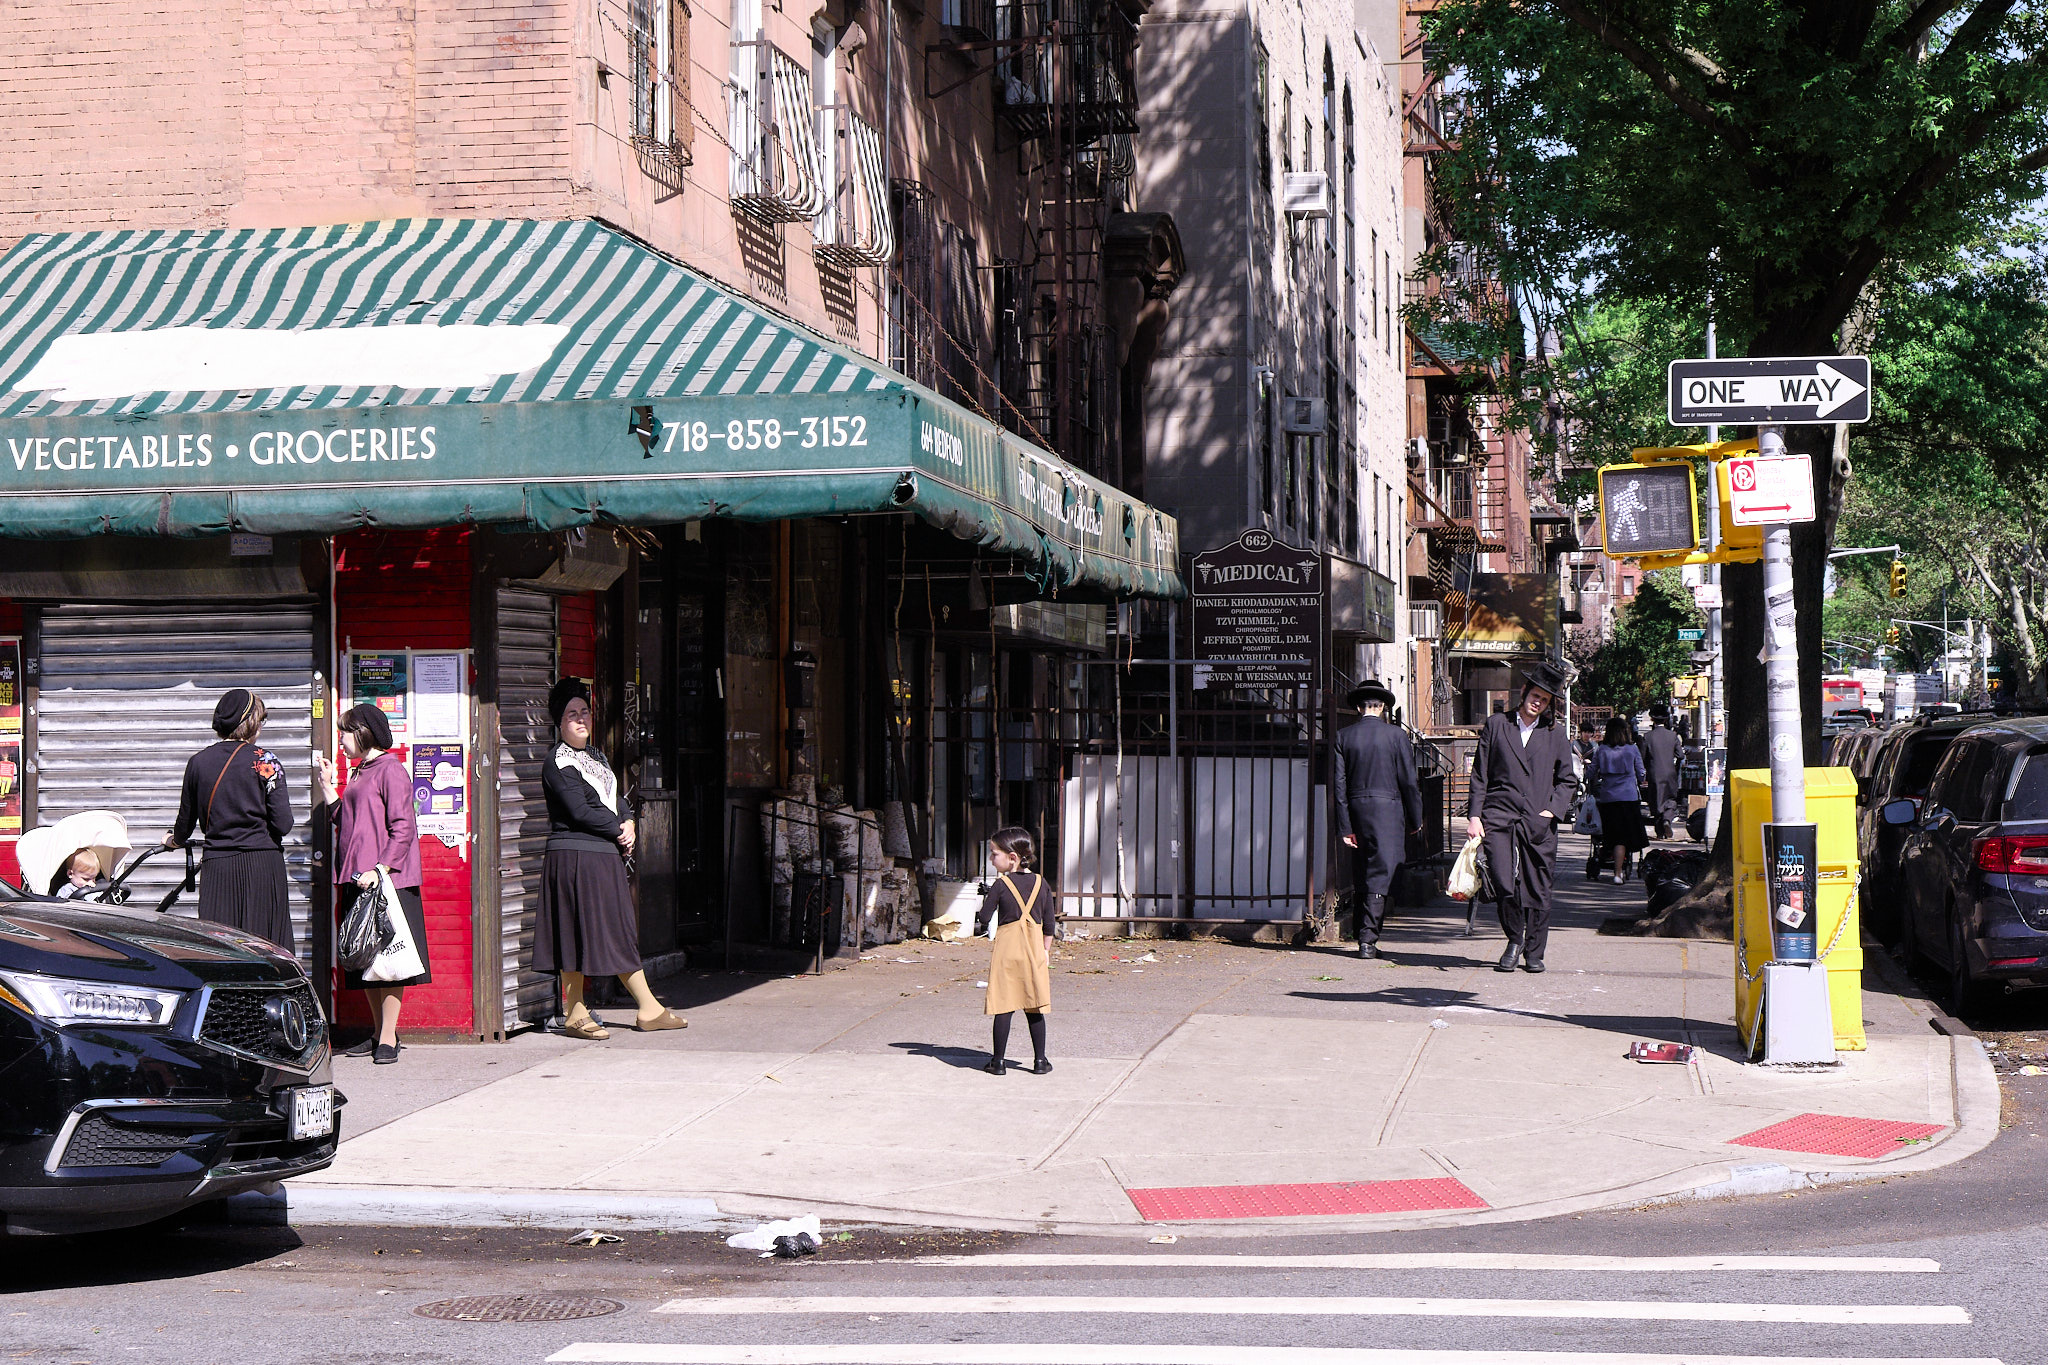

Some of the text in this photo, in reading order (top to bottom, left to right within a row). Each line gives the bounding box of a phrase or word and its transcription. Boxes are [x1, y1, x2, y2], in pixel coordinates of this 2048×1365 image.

[1689, 378, 1841, 404] ONE WAY
[663, 415, 868, 453] 718-858-3152
[7, 425, 436, 471] VEGETABLES GROCERIES
[921, 420, 963, 467] 664 BEDFORD
[1246, 535, 1268, 546] 662
[1213, 564, 1300, 585] MEDICAL
[1196, 598, 1320, 608] DANIEL KHODADADIAN, M.D.
[1216, 617, 1238, 626] TZVI
[1281, 616, 1298, 625] D.C.
[1680, 630, 1698, 639] Penn
[1203, 635, 1312, 645] JEFFREY KNOBEL, D.P.M.
[1466, 641, 1521, 650] Landau's
[1246, 673, 1296, 682] WEISSMAN,
